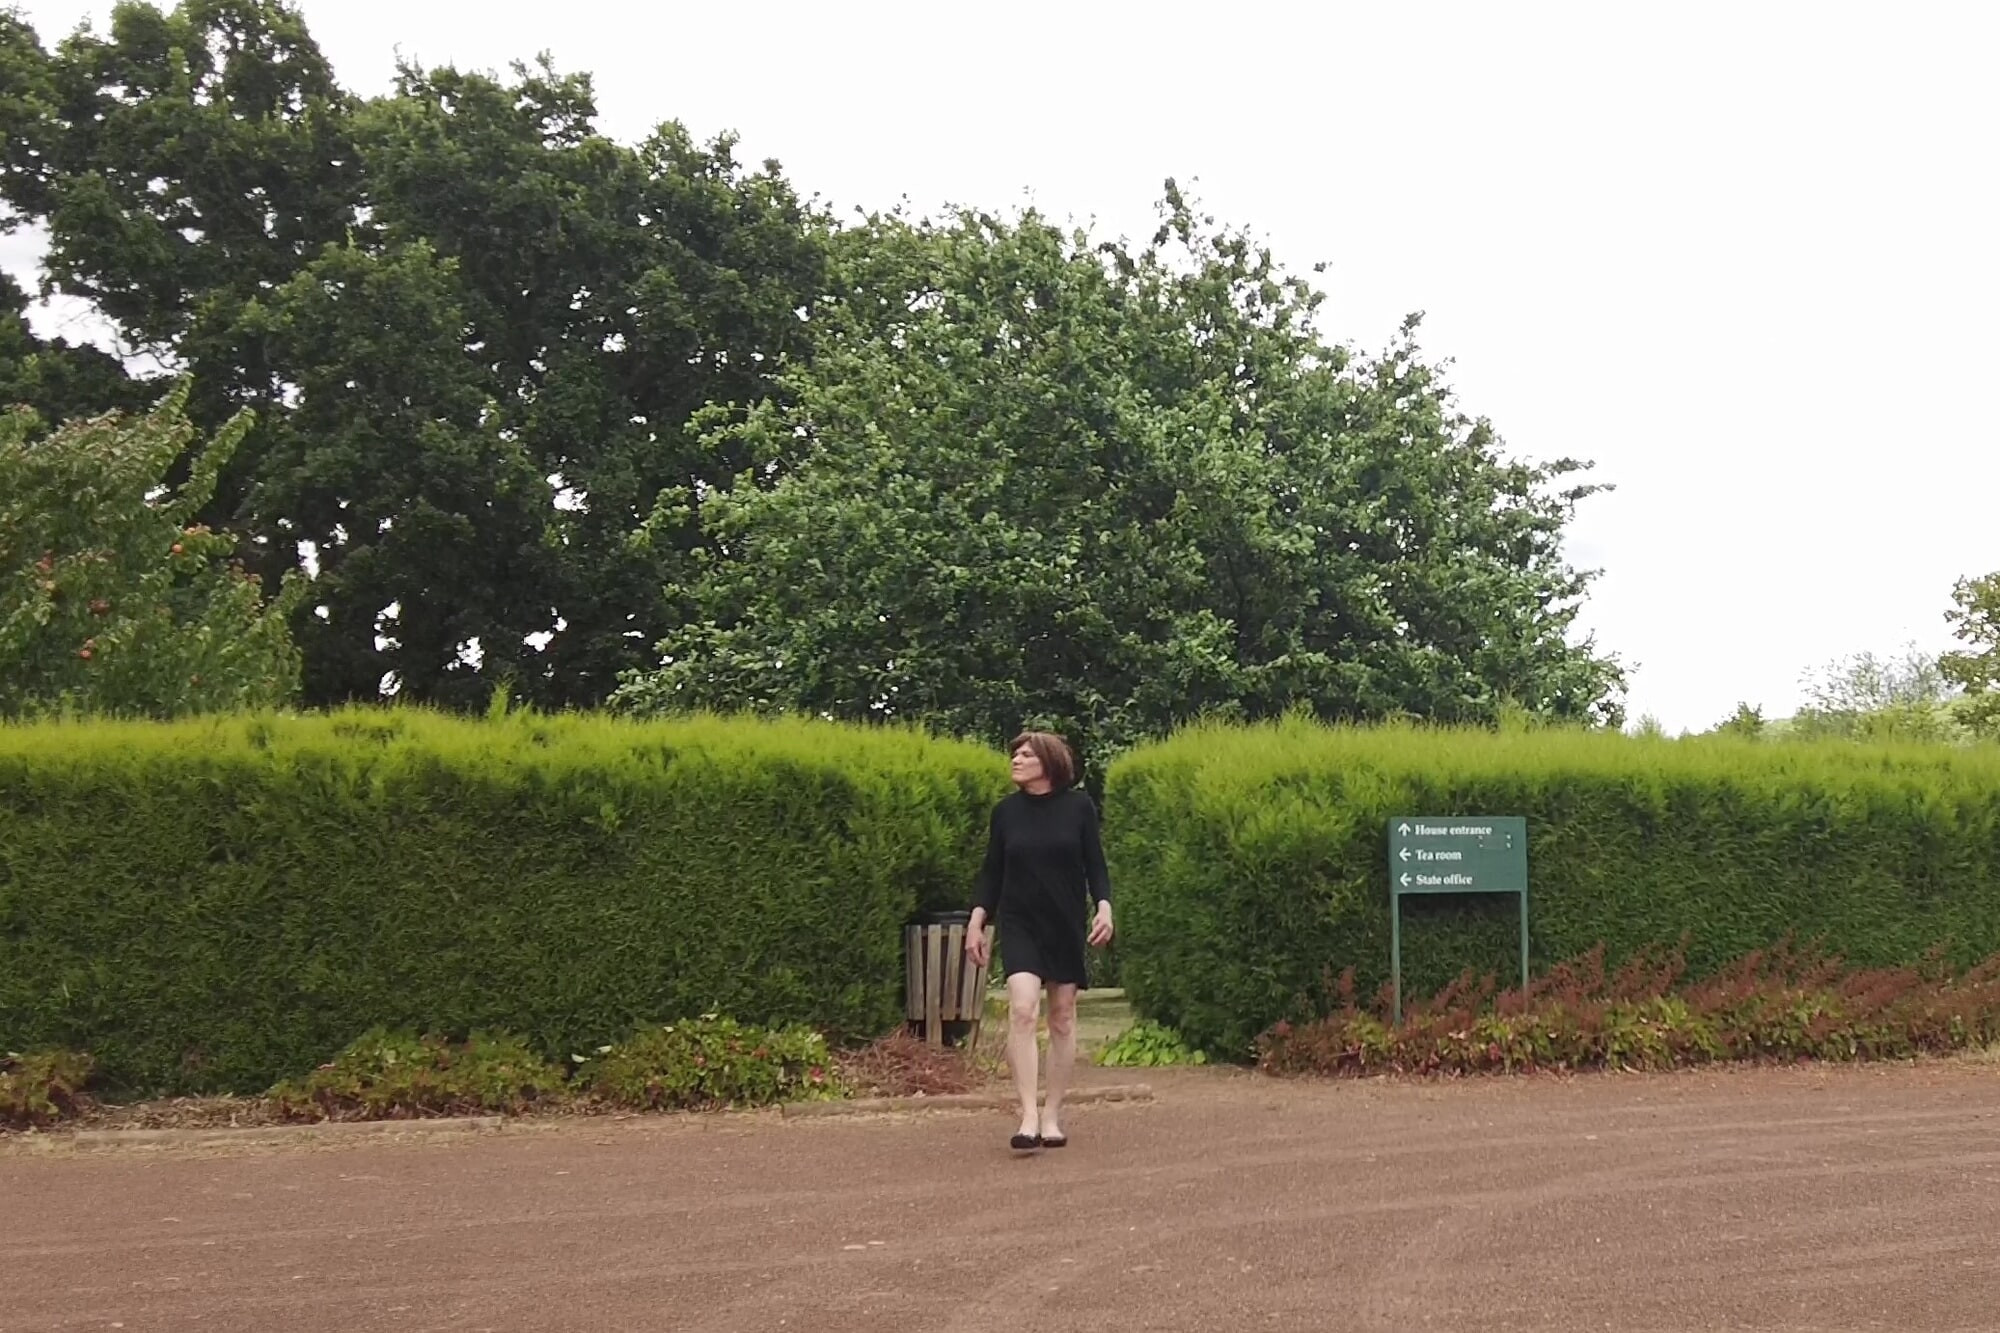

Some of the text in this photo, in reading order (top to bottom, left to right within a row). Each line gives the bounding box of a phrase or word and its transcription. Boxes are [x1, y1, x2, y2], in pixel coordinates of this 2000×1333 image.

[1415, 824, 1493, 836] House entrance
[1415, 849, 1462, 861] Tea room
[1443, 873, 1473, 885] office
